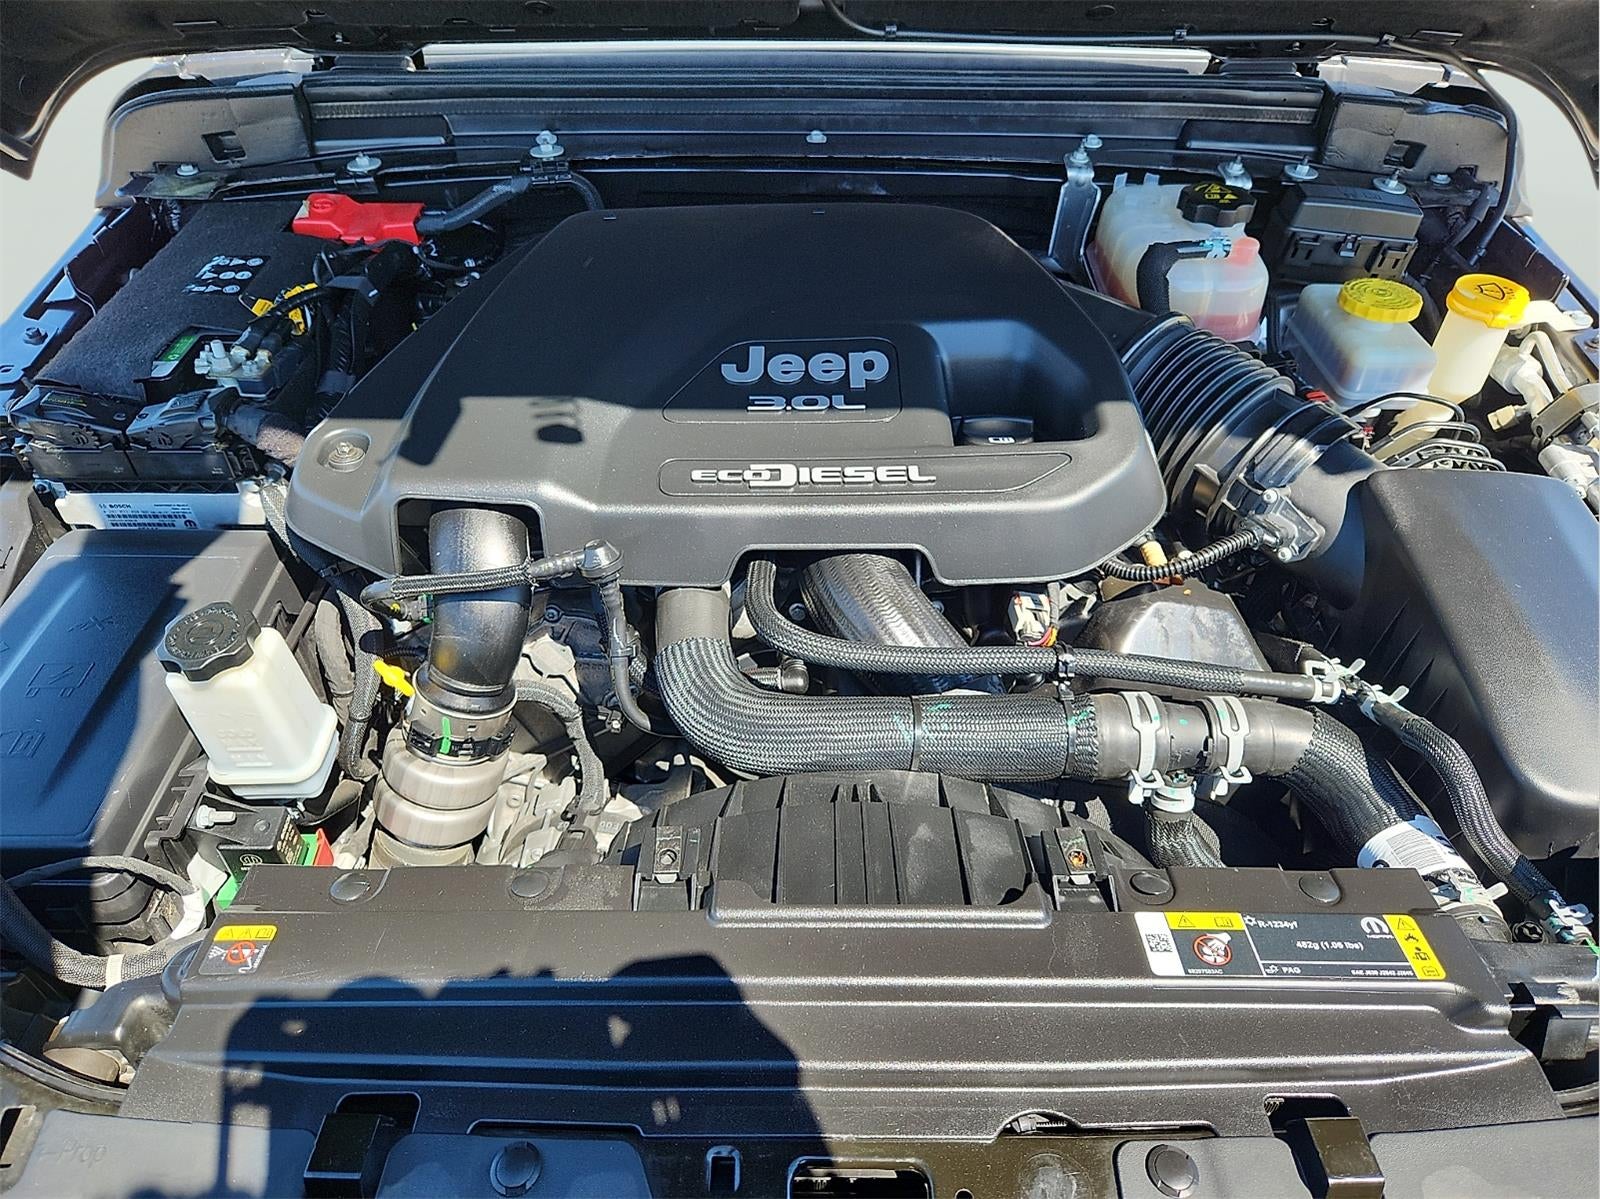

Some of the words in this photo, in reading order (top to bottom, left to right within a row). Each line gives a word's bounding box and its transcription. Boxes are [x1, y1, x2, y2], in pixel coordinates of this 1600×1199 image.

[720, 345, 890, 390] Jeep
[747, 395, 866, 411] 3.0L
[1281, 966, 1301, 974] PAG
